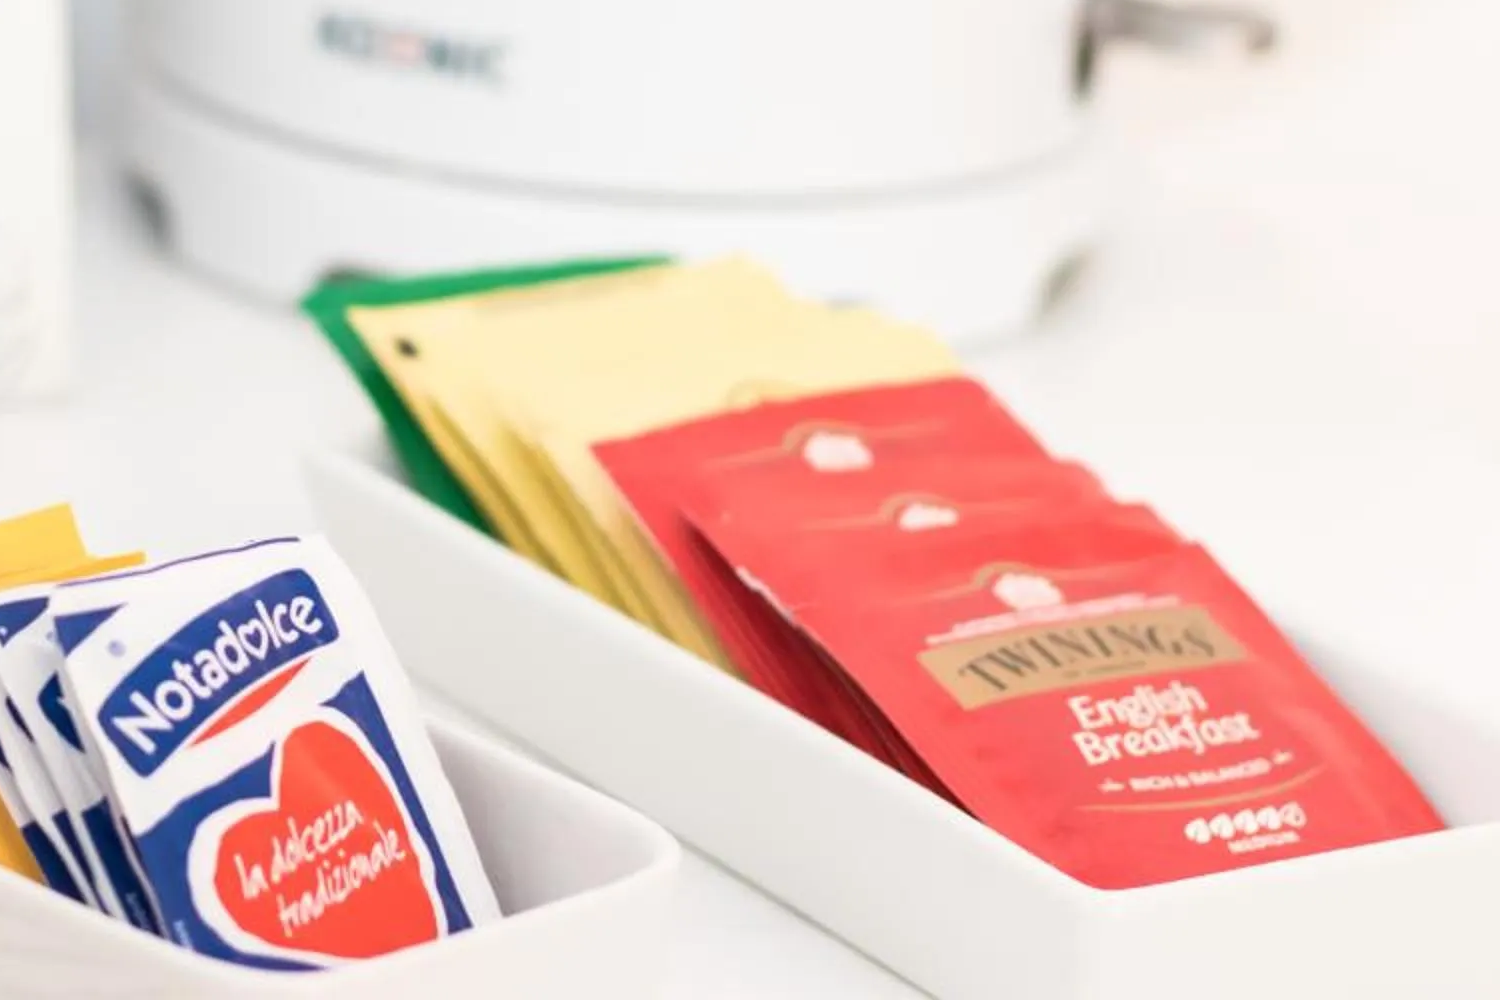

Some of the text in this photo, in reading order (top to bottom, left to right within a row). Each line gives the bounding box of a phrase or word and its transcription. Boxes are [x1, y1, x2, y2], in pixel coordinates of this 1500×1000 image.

[111, 596, 324, 756] Notadolce
[957, 624, 1216, 691] TWININGS
[1068, 679, 1209, 731] English
[1072, 712, 1261, 766] Breakfast
[233, 799, 365, 900] la dolcezza
[276, 819, 407, 938] tradizionale
